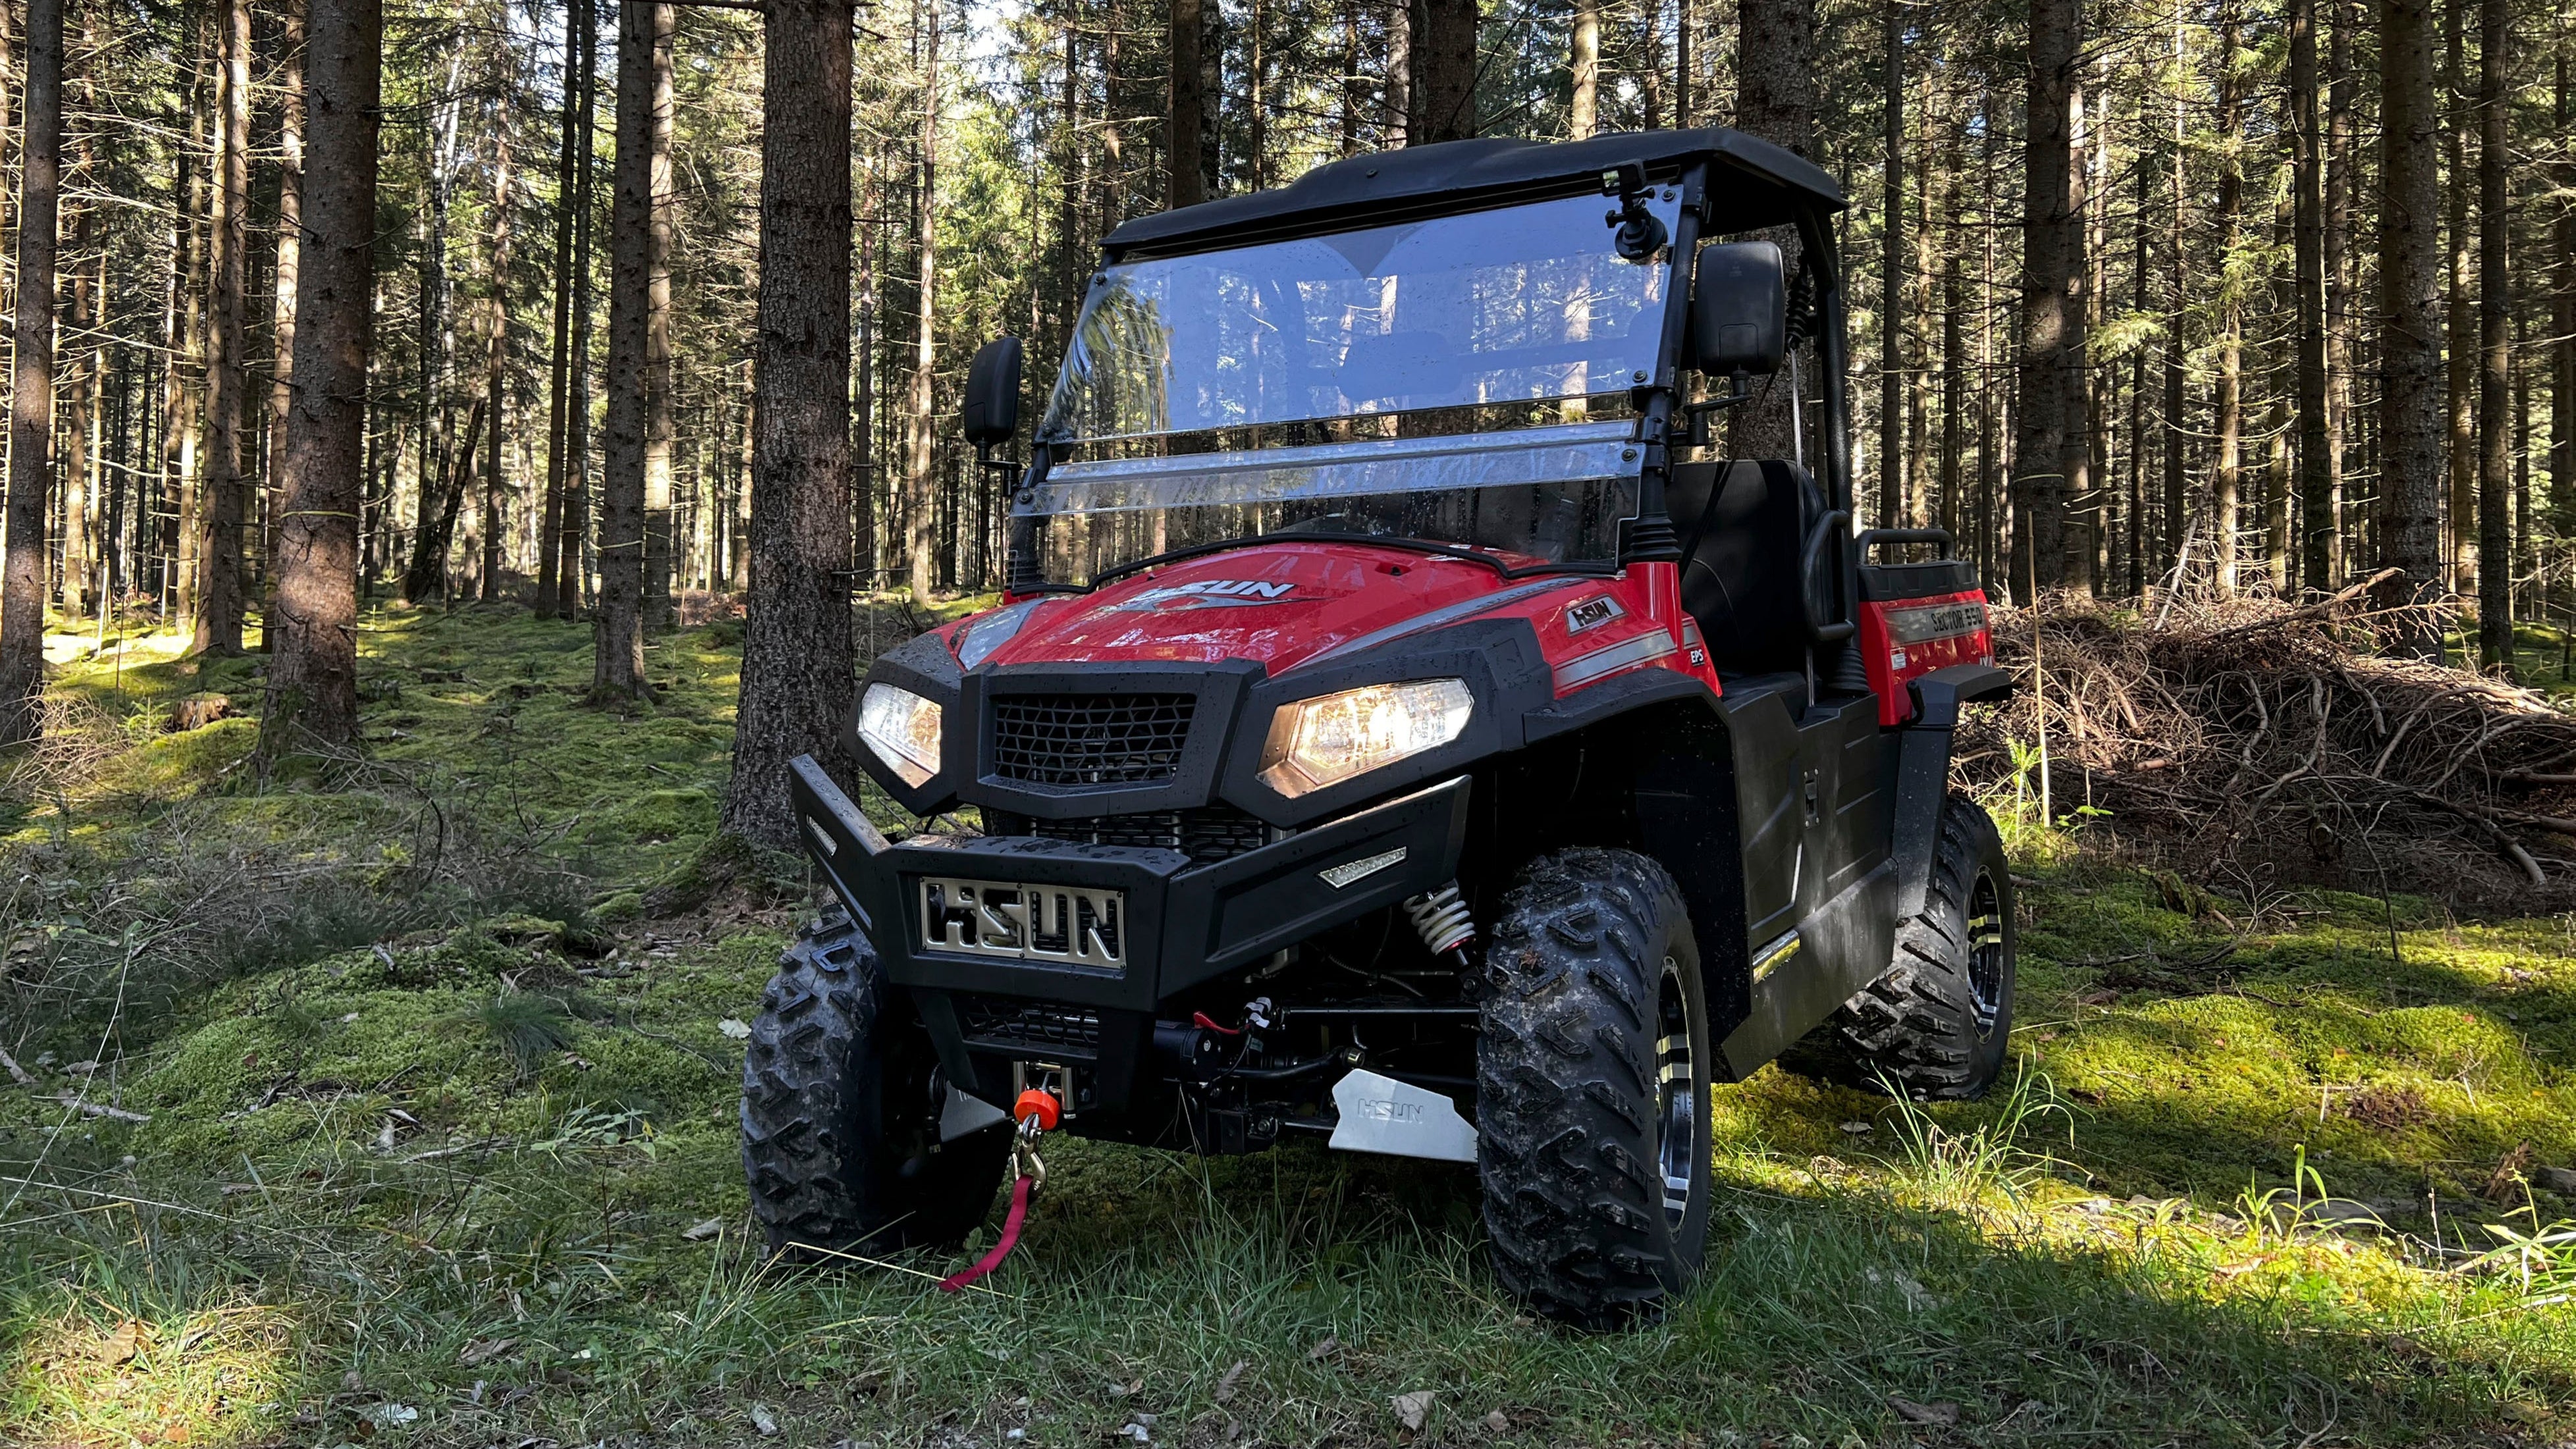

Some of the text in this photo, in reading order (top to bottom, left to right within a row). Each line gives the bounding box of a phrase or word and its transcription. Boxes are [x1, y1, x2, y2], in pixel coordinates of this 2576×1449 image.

[1572, 600, 1613, 627] HSUN
[1931, 607, 1983, 632] SECTOR 550
[1690, 648, 1704, 663] EPS
[926, 883, 1119, 961] HSUN
[1357, 1098, 1424, 1124] HSUN
